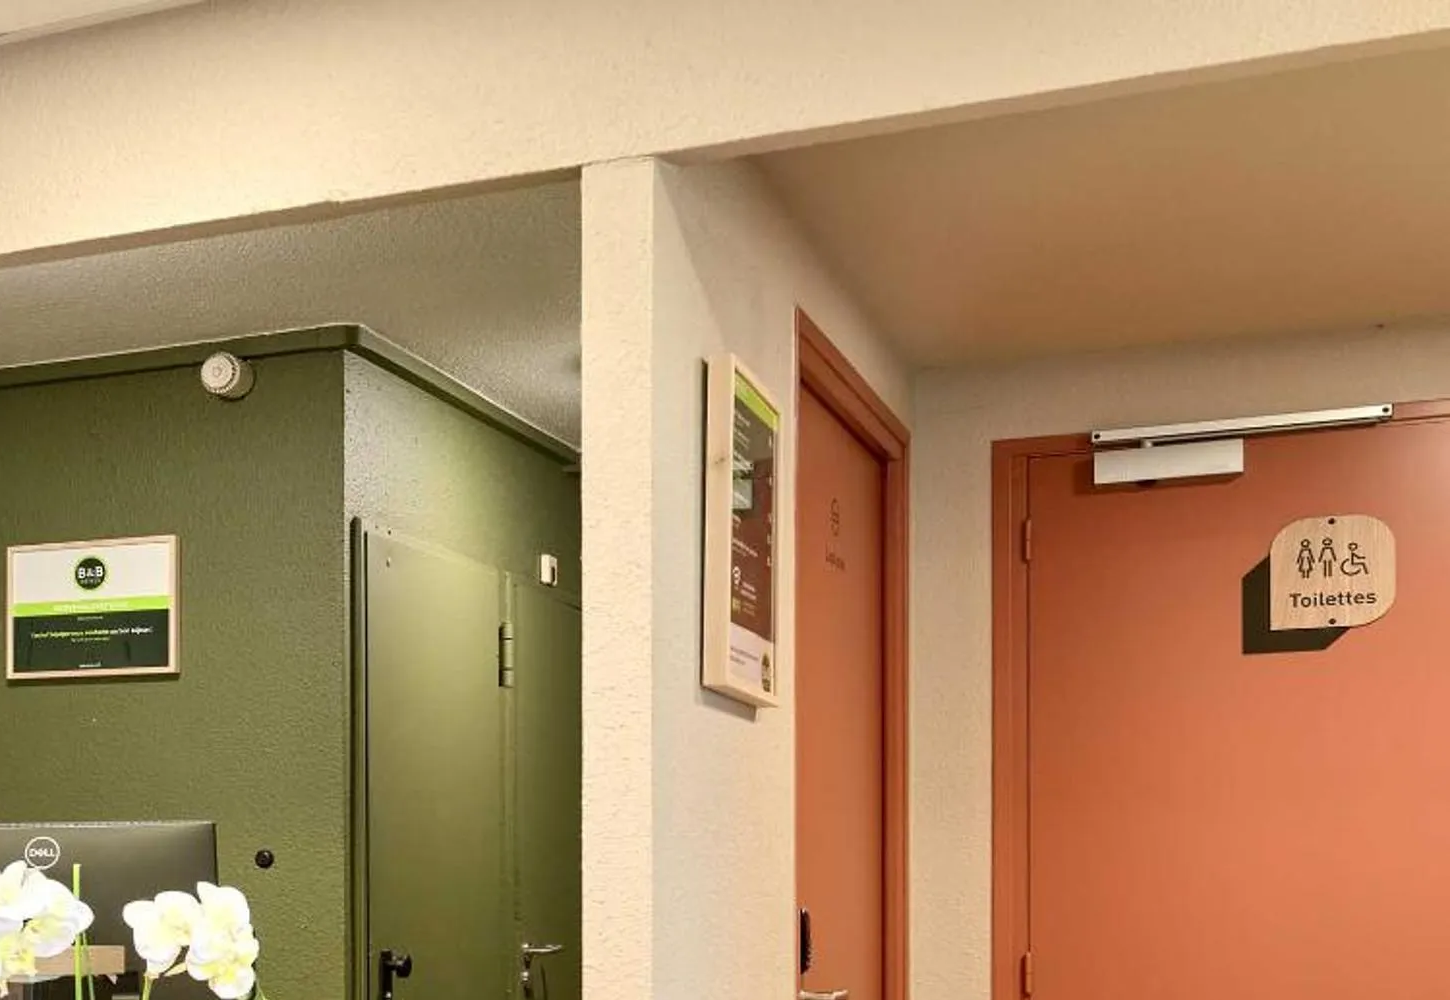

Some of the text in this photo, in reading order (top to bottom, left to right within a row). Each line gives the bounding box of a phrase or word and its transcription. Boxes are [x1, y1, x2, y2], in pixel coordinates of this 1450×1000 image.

[78, 566, 103, 579] B&B
[1289, 592, 1377, 608] Toilettes
[29, 848, 55, 857] DELL
